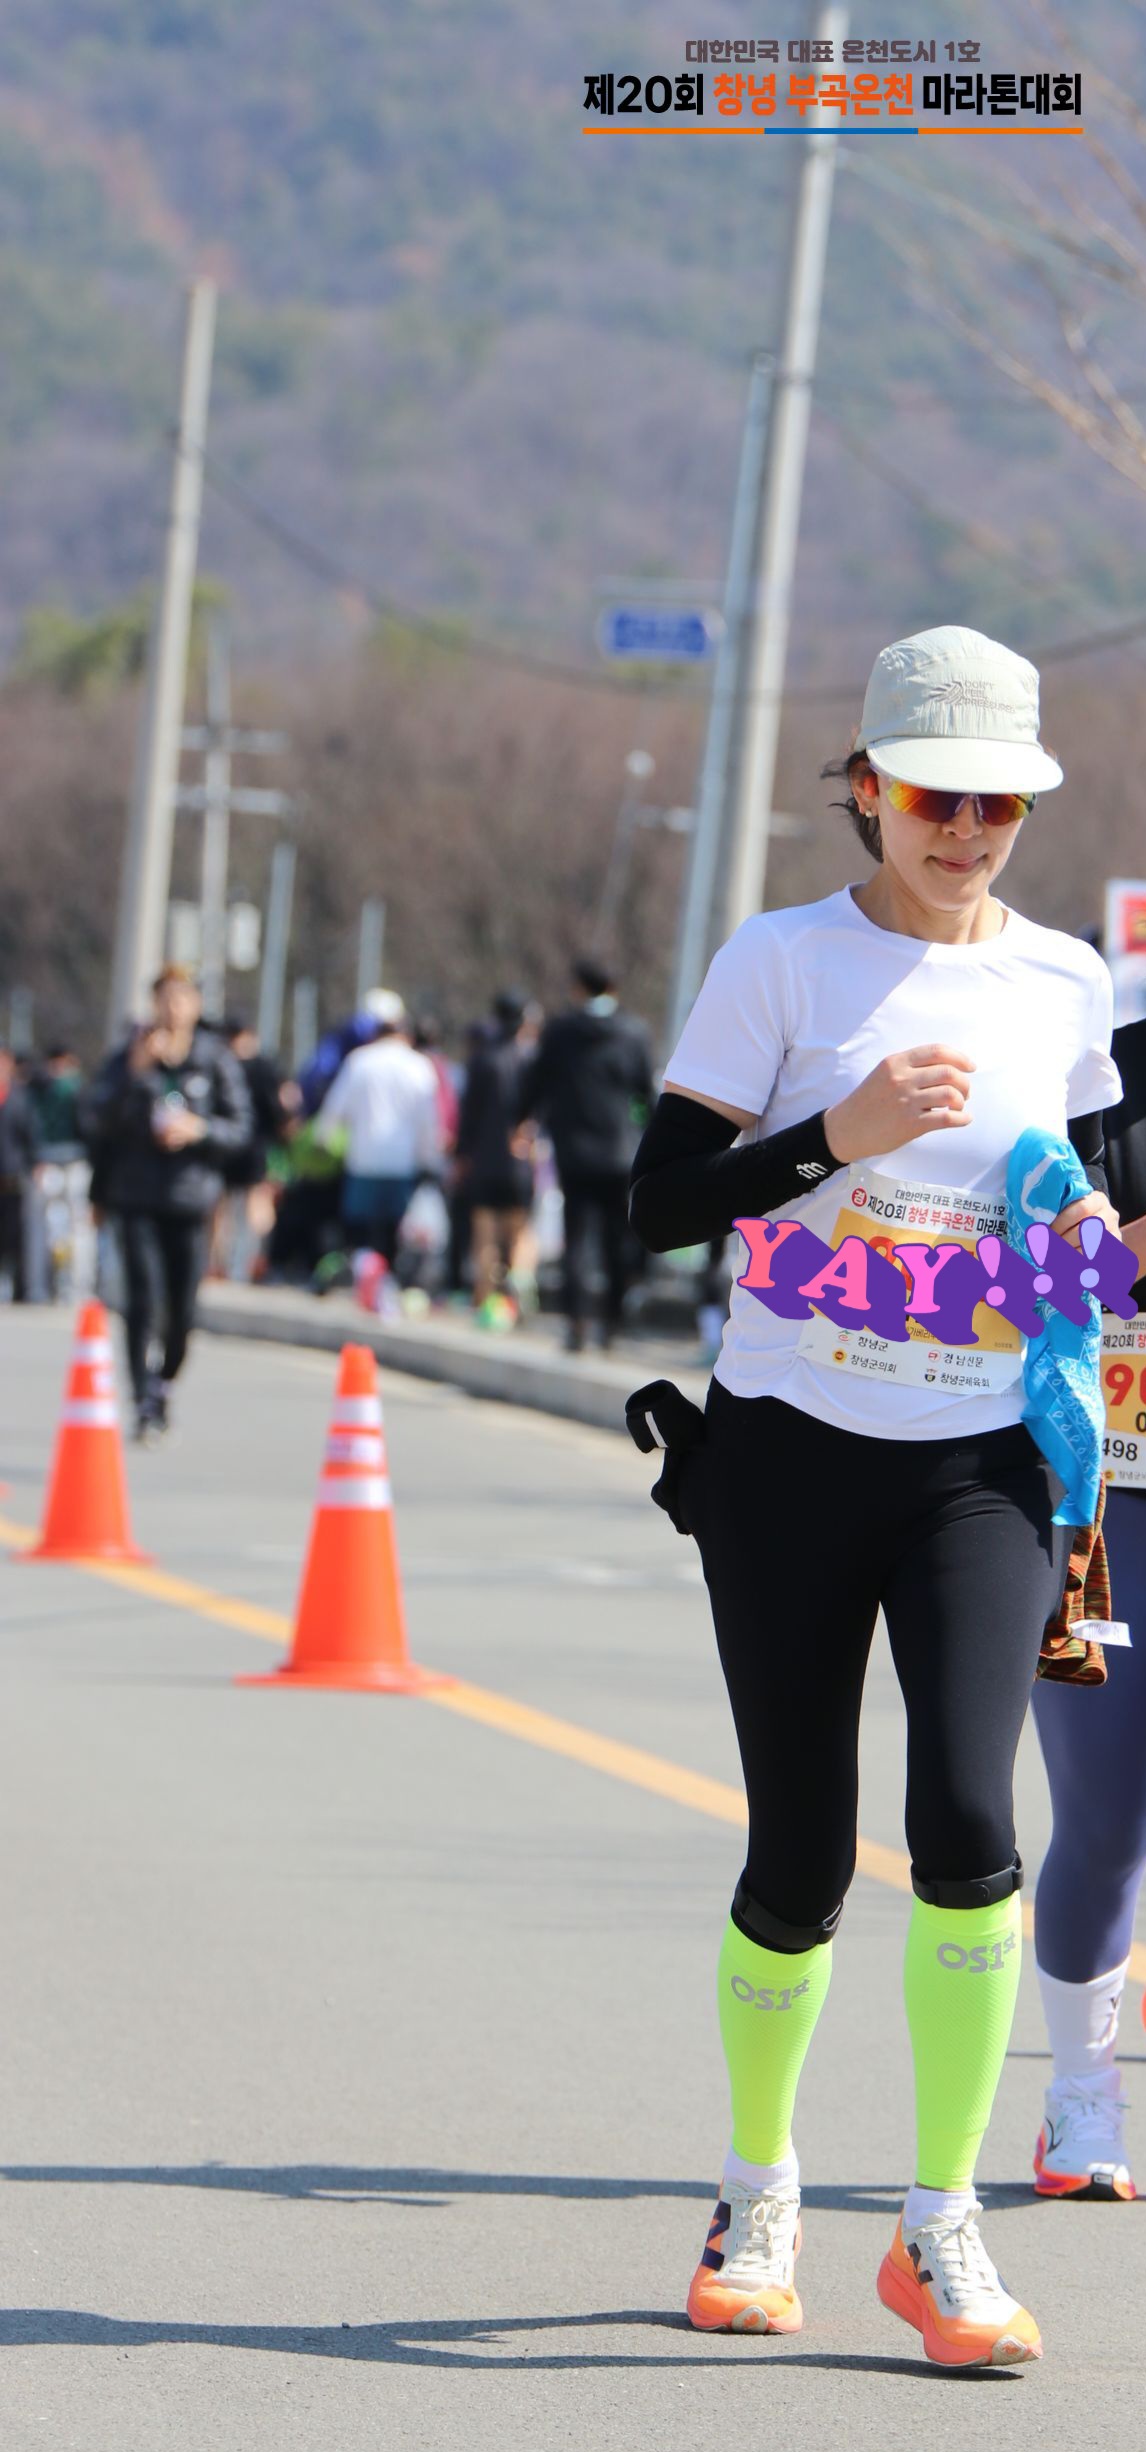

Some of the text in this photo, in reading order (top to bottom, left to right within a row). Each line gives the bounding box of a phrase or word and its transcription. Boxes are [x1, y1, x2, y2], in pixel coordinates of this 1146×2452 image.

[895, 1189, 930, 1203] 대한민국
[933, 1194, 950, 1206] 대표
[953, 1198, 991, 1214] 온천도시
[867, 1195, 906, 1221] 제20회
[908, 1206, 929, 1225] 창녕
[930, 1210, 975, 1232] 부곡온천
[858, 1336, 888, 1352] 창녕군
[1103, 1334, 1134, 1348] 제20회
[851, 1354, 897, 1374] 창녕군의회
[940, 1373, 990, 1387] 창녕군체육회
